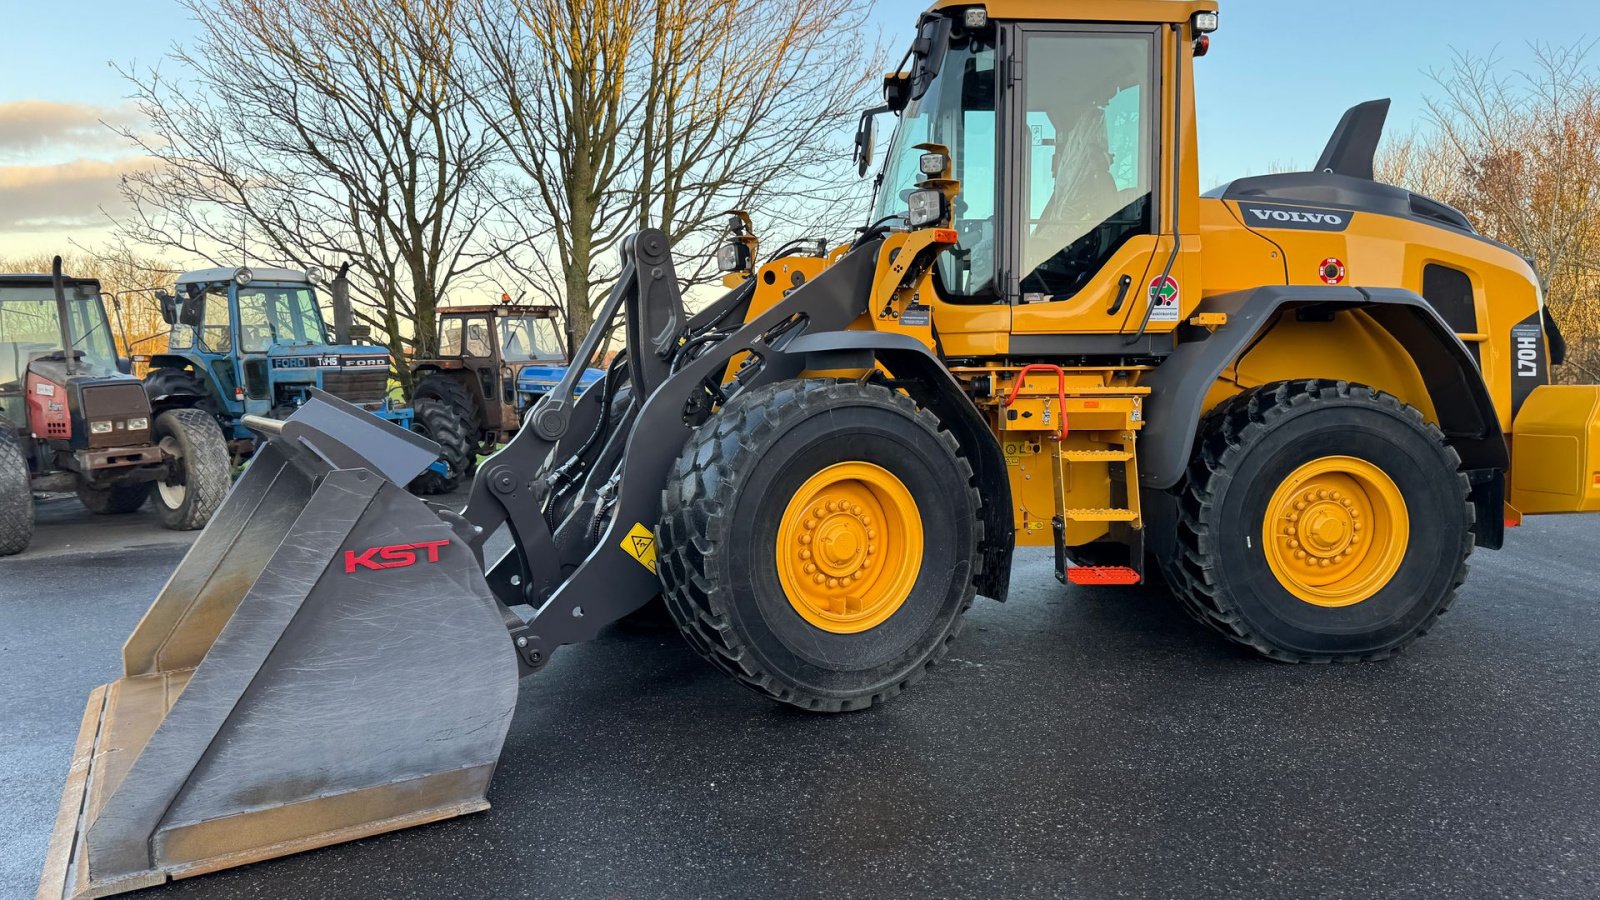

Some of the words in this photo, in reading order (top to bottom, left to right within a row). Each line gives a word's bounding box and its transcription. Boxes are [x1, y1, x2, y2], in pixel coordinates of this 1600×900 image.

[1249, 208, 1342, 225] VOLVO
[275, 358, 306, 368] FORD
[345, 359, 386, 367] FORD
[1517, 337, 1537, 377] L70H
[344, 539, 451, 573] KST
